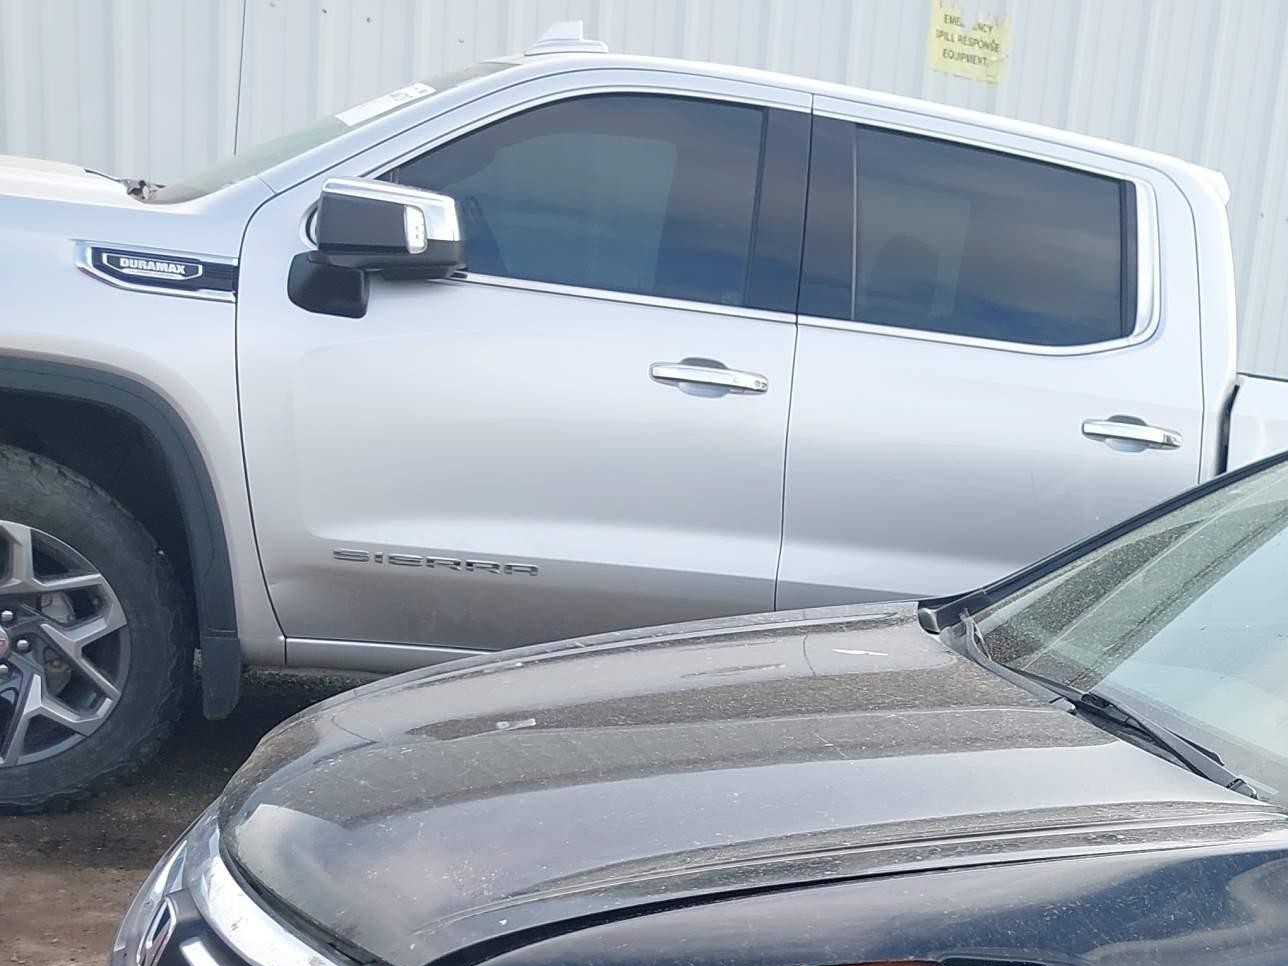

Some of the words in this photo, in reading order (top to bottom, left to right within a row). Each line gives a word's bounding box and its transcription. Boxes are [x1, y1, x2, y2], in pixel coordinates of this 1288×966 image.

[957, 34, 1000, 53] RESPONSE
[942, 48, 988, 65] EQUIPMENT
[120, 257, 186, 274] DURAMAX
[332, 547, 539, 577] SIERRA
